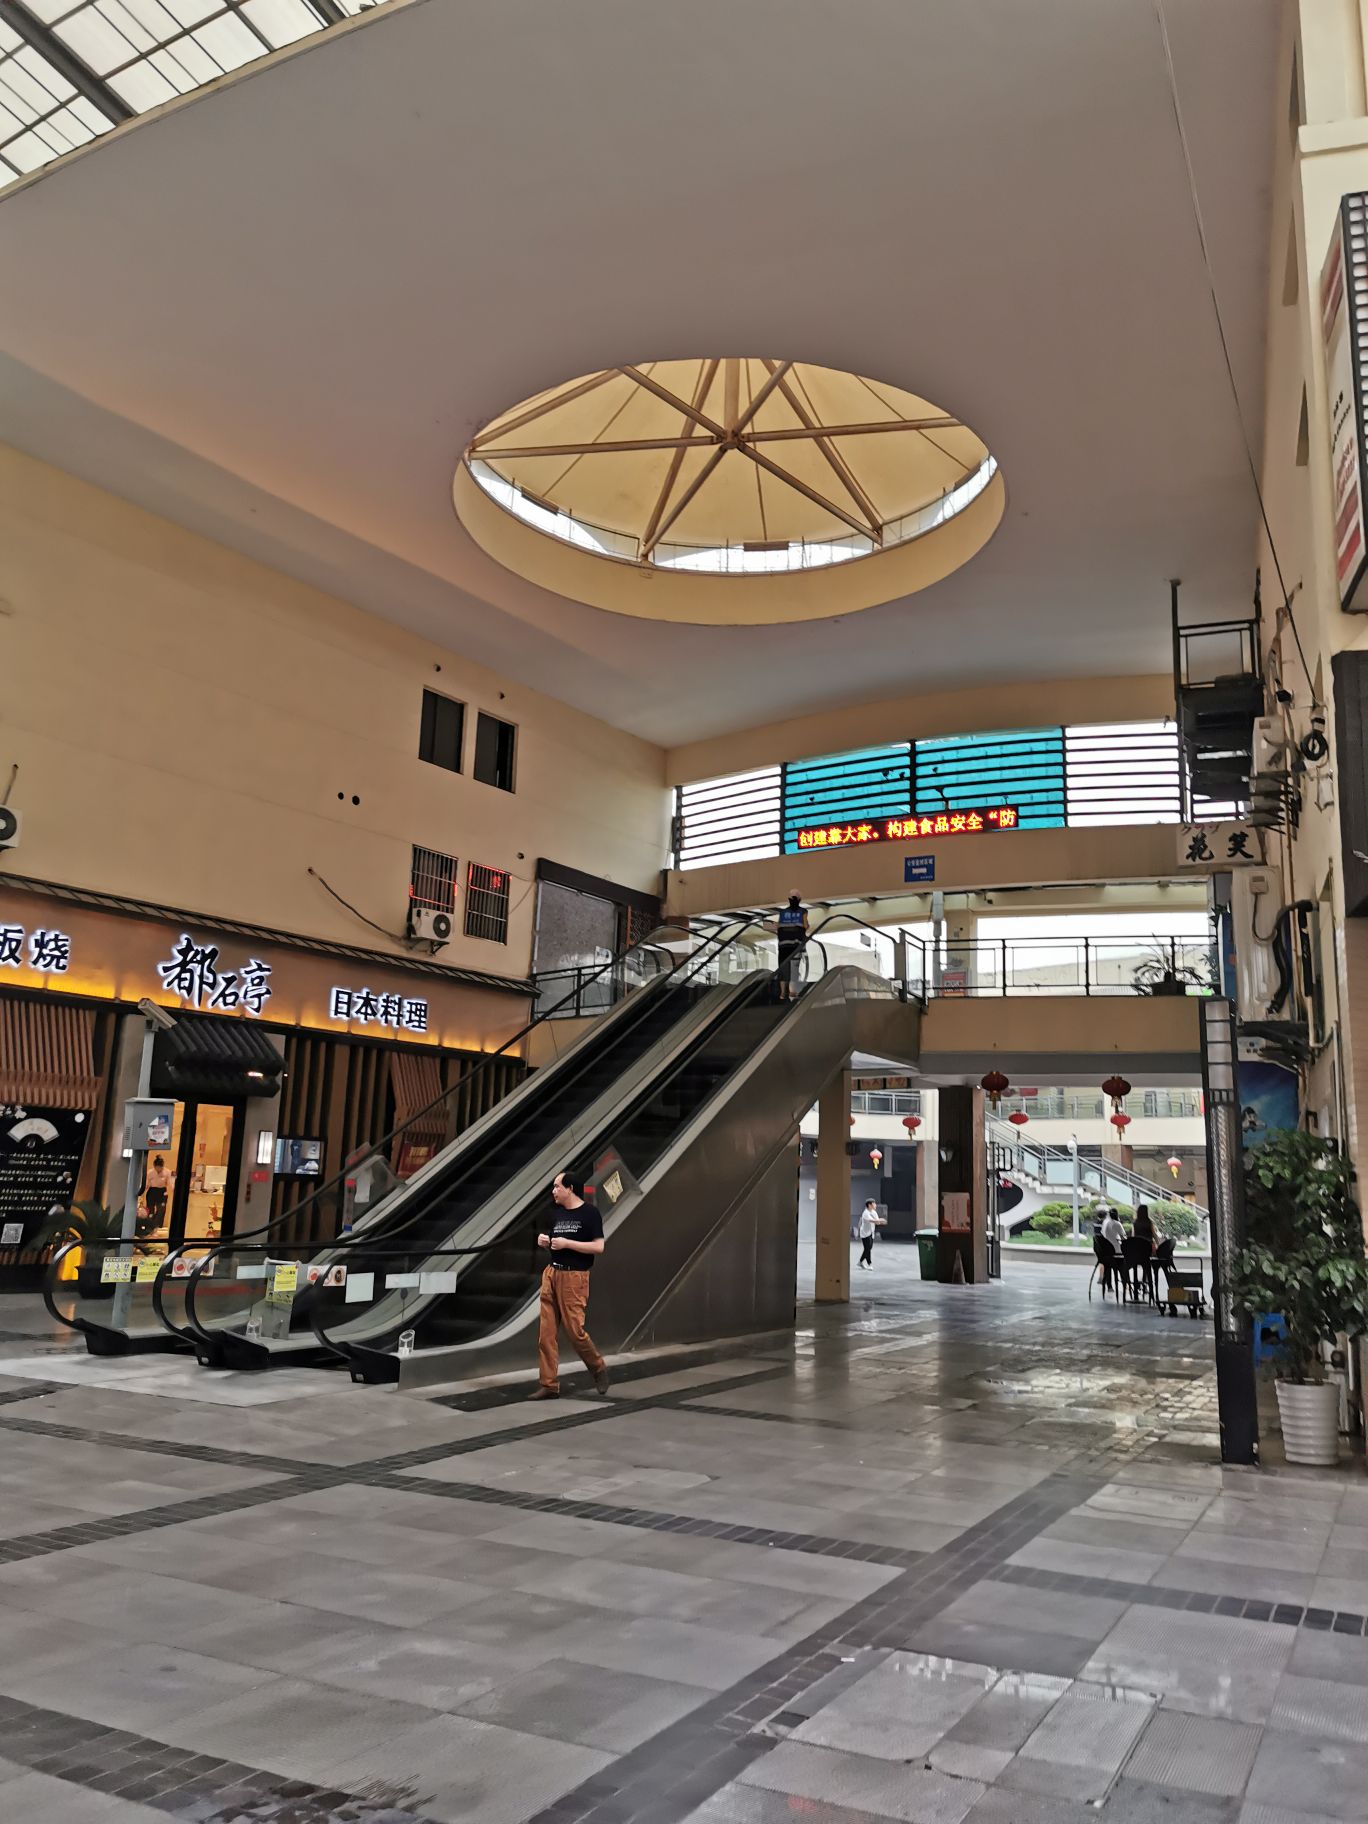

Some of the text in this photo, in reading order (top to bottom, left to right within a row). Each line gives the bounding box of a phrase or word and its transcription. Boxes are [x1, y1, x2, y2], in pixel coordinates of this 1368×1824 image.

[160, 935, 273, 1014] 都石亭
[331, 987, 430, 1032] 日本料理
